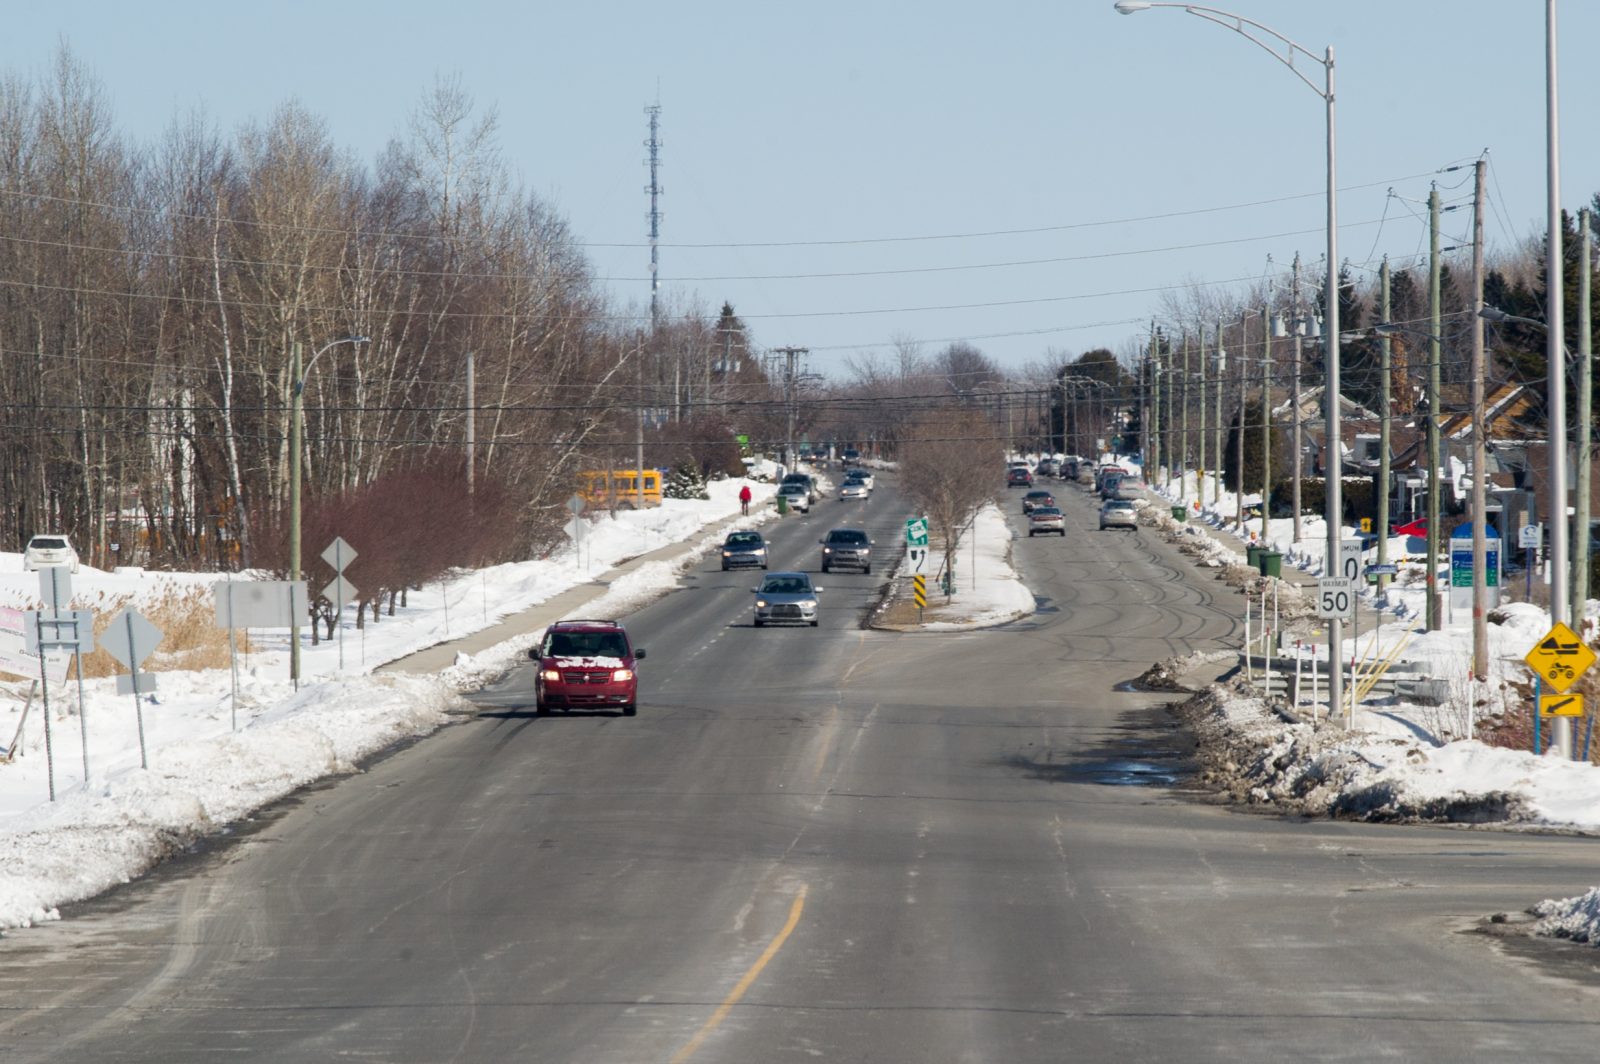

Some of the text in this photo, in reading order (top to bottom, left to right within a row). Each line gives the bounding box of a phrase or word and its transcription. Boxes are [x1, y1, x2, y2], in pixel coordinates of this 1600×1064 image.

[1341, 544, 1360, 552] IMUM
[1345, 557, 1358, 581] 0
[1322, 591, 1348, 612] 50
